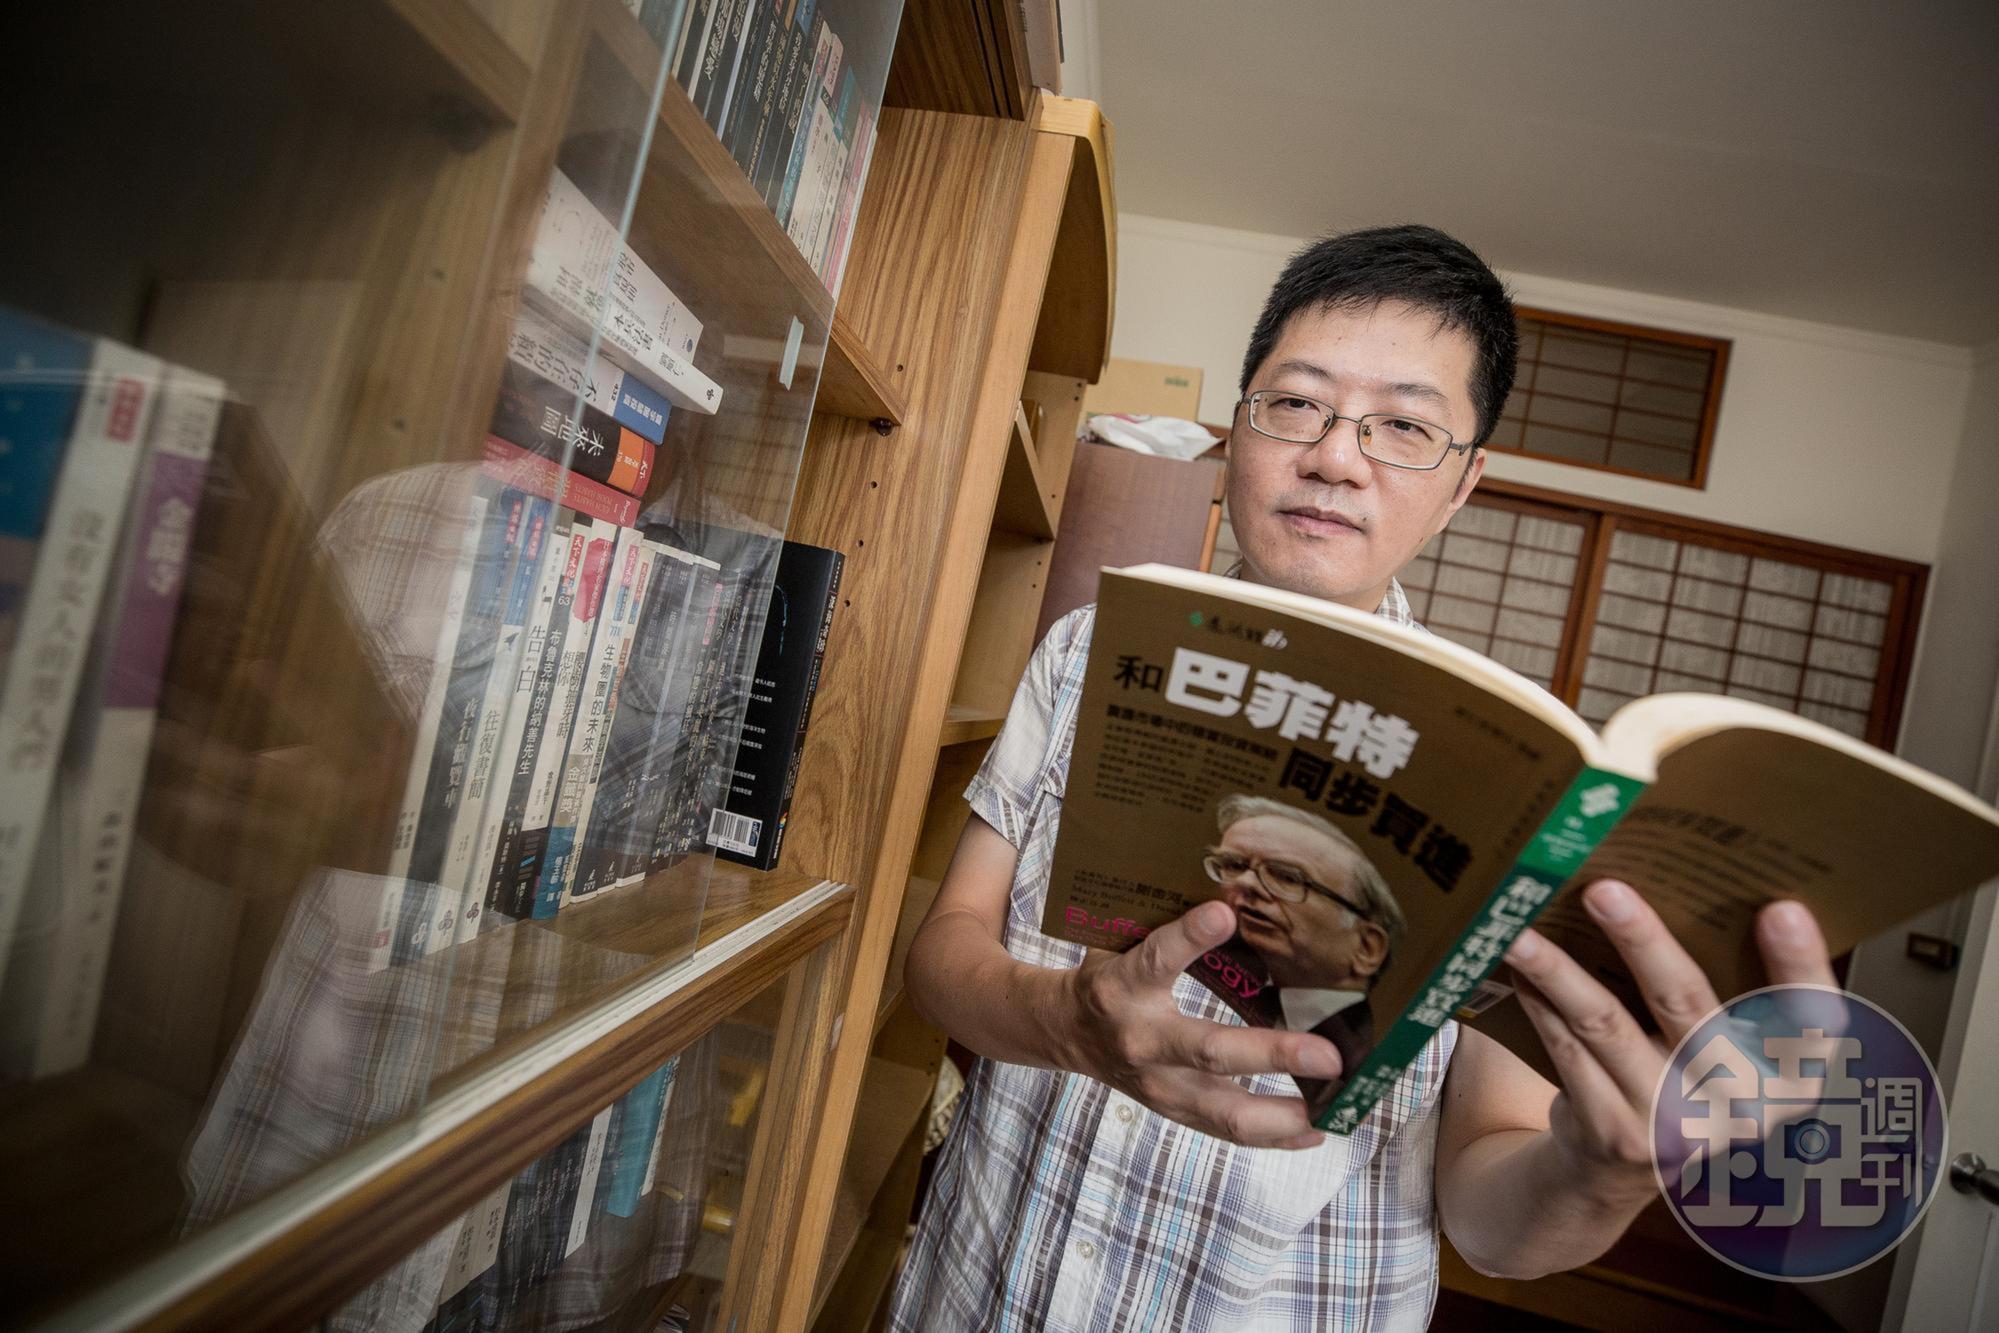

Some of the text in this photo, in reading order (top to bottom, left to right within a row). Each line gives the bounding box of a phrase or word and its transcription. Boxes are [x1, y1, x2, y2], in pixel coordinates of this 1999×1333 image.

[540, 407, 606, 457] 未來地圖
[566, 534, 583, 580] 天下文化
[621, 545, 639, 585] 天下文化
[557, 594, 571, 607] 63
[516, 625, 546, 694] 告白
[582, 644, 616, 752] 生物圈的未來
[466, 709, 501, 802] 往復書簡
[1278, 748, 1475, 894] 同步買進
